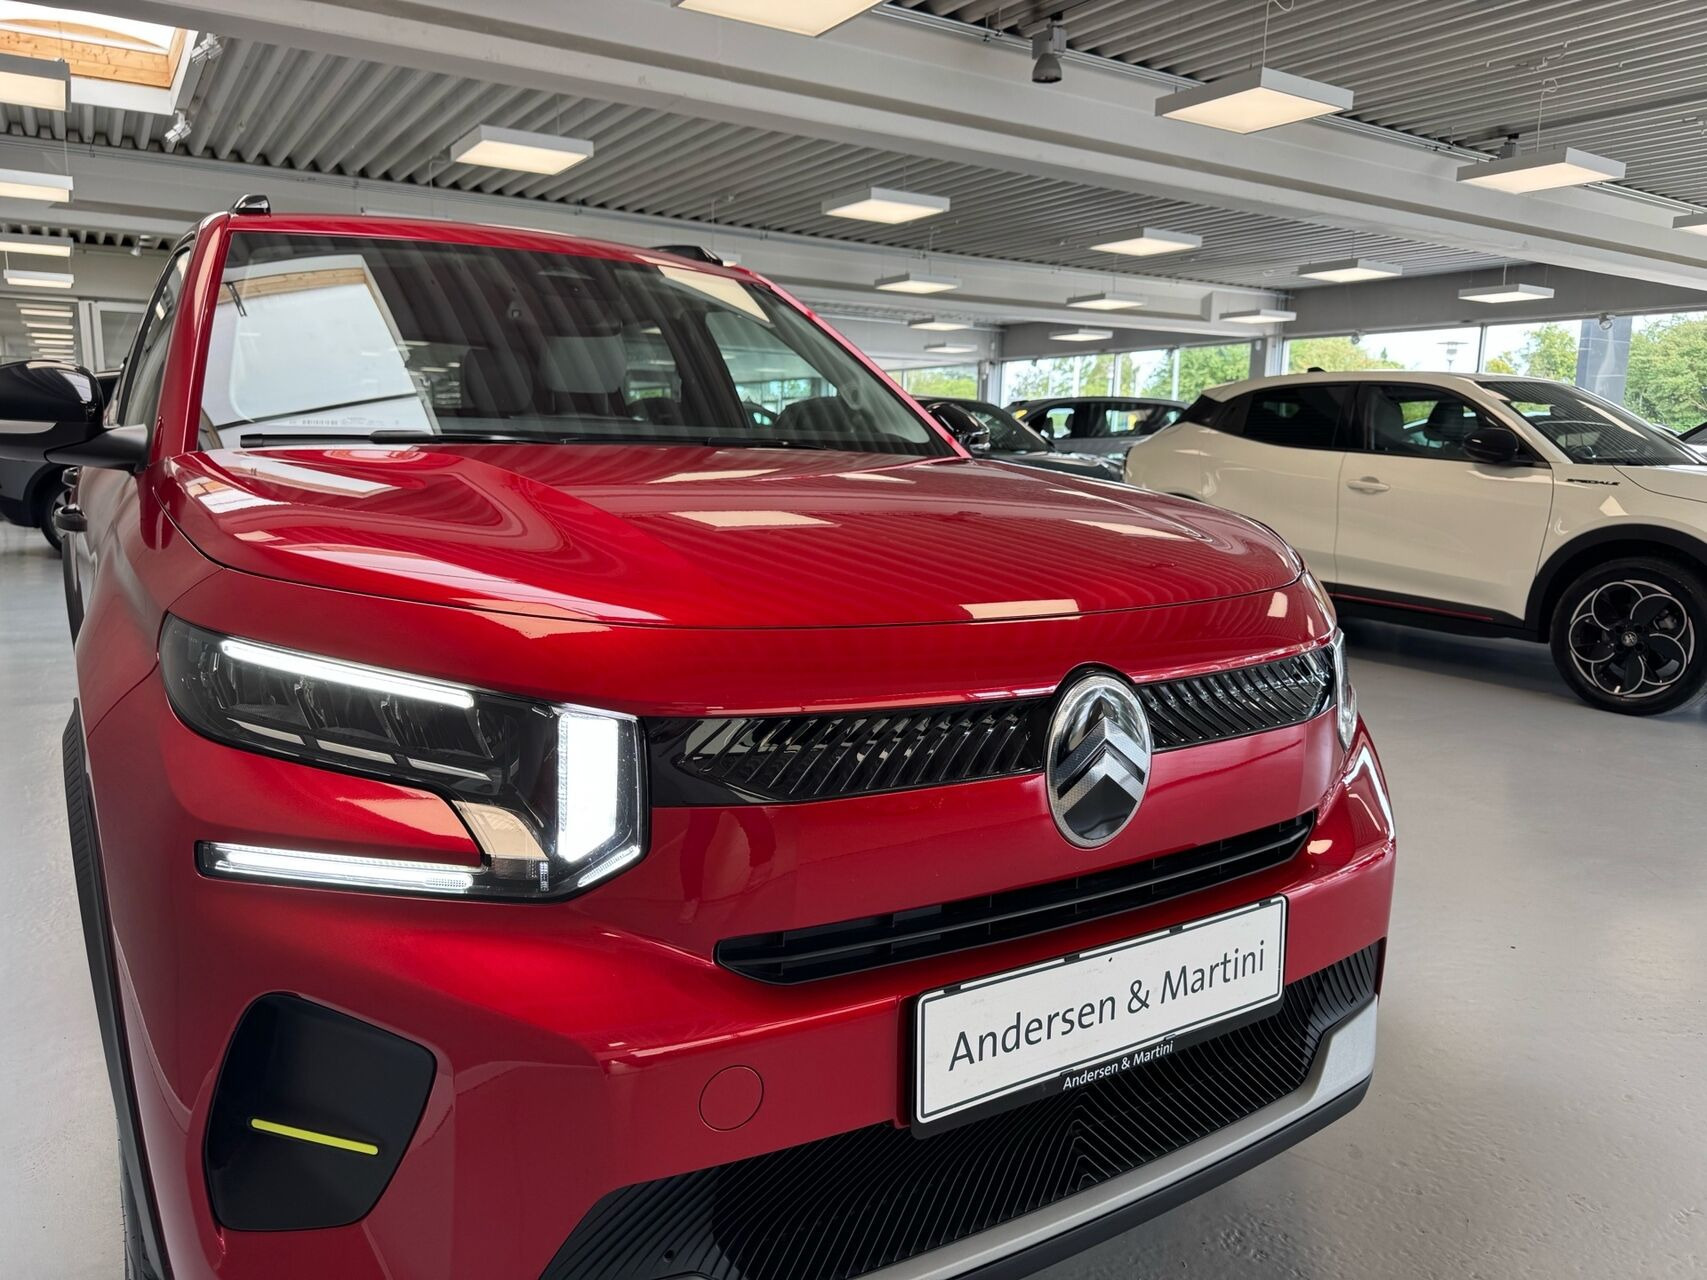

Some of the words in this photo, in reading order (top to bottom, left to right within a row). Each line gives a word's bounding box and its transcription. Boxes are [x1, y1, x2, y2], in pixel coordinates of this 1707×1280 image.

[948, 995, 1116, 1072] Andersen
[1127, 979, 1150, 1014] &
[1160, 939, 1265, 1004] Martini
[1062, 1060, 1118, 1091] Andersen
[1121, 1056, 1131, 1069] &
[1133, 1040, 1174, 1066] Martini
